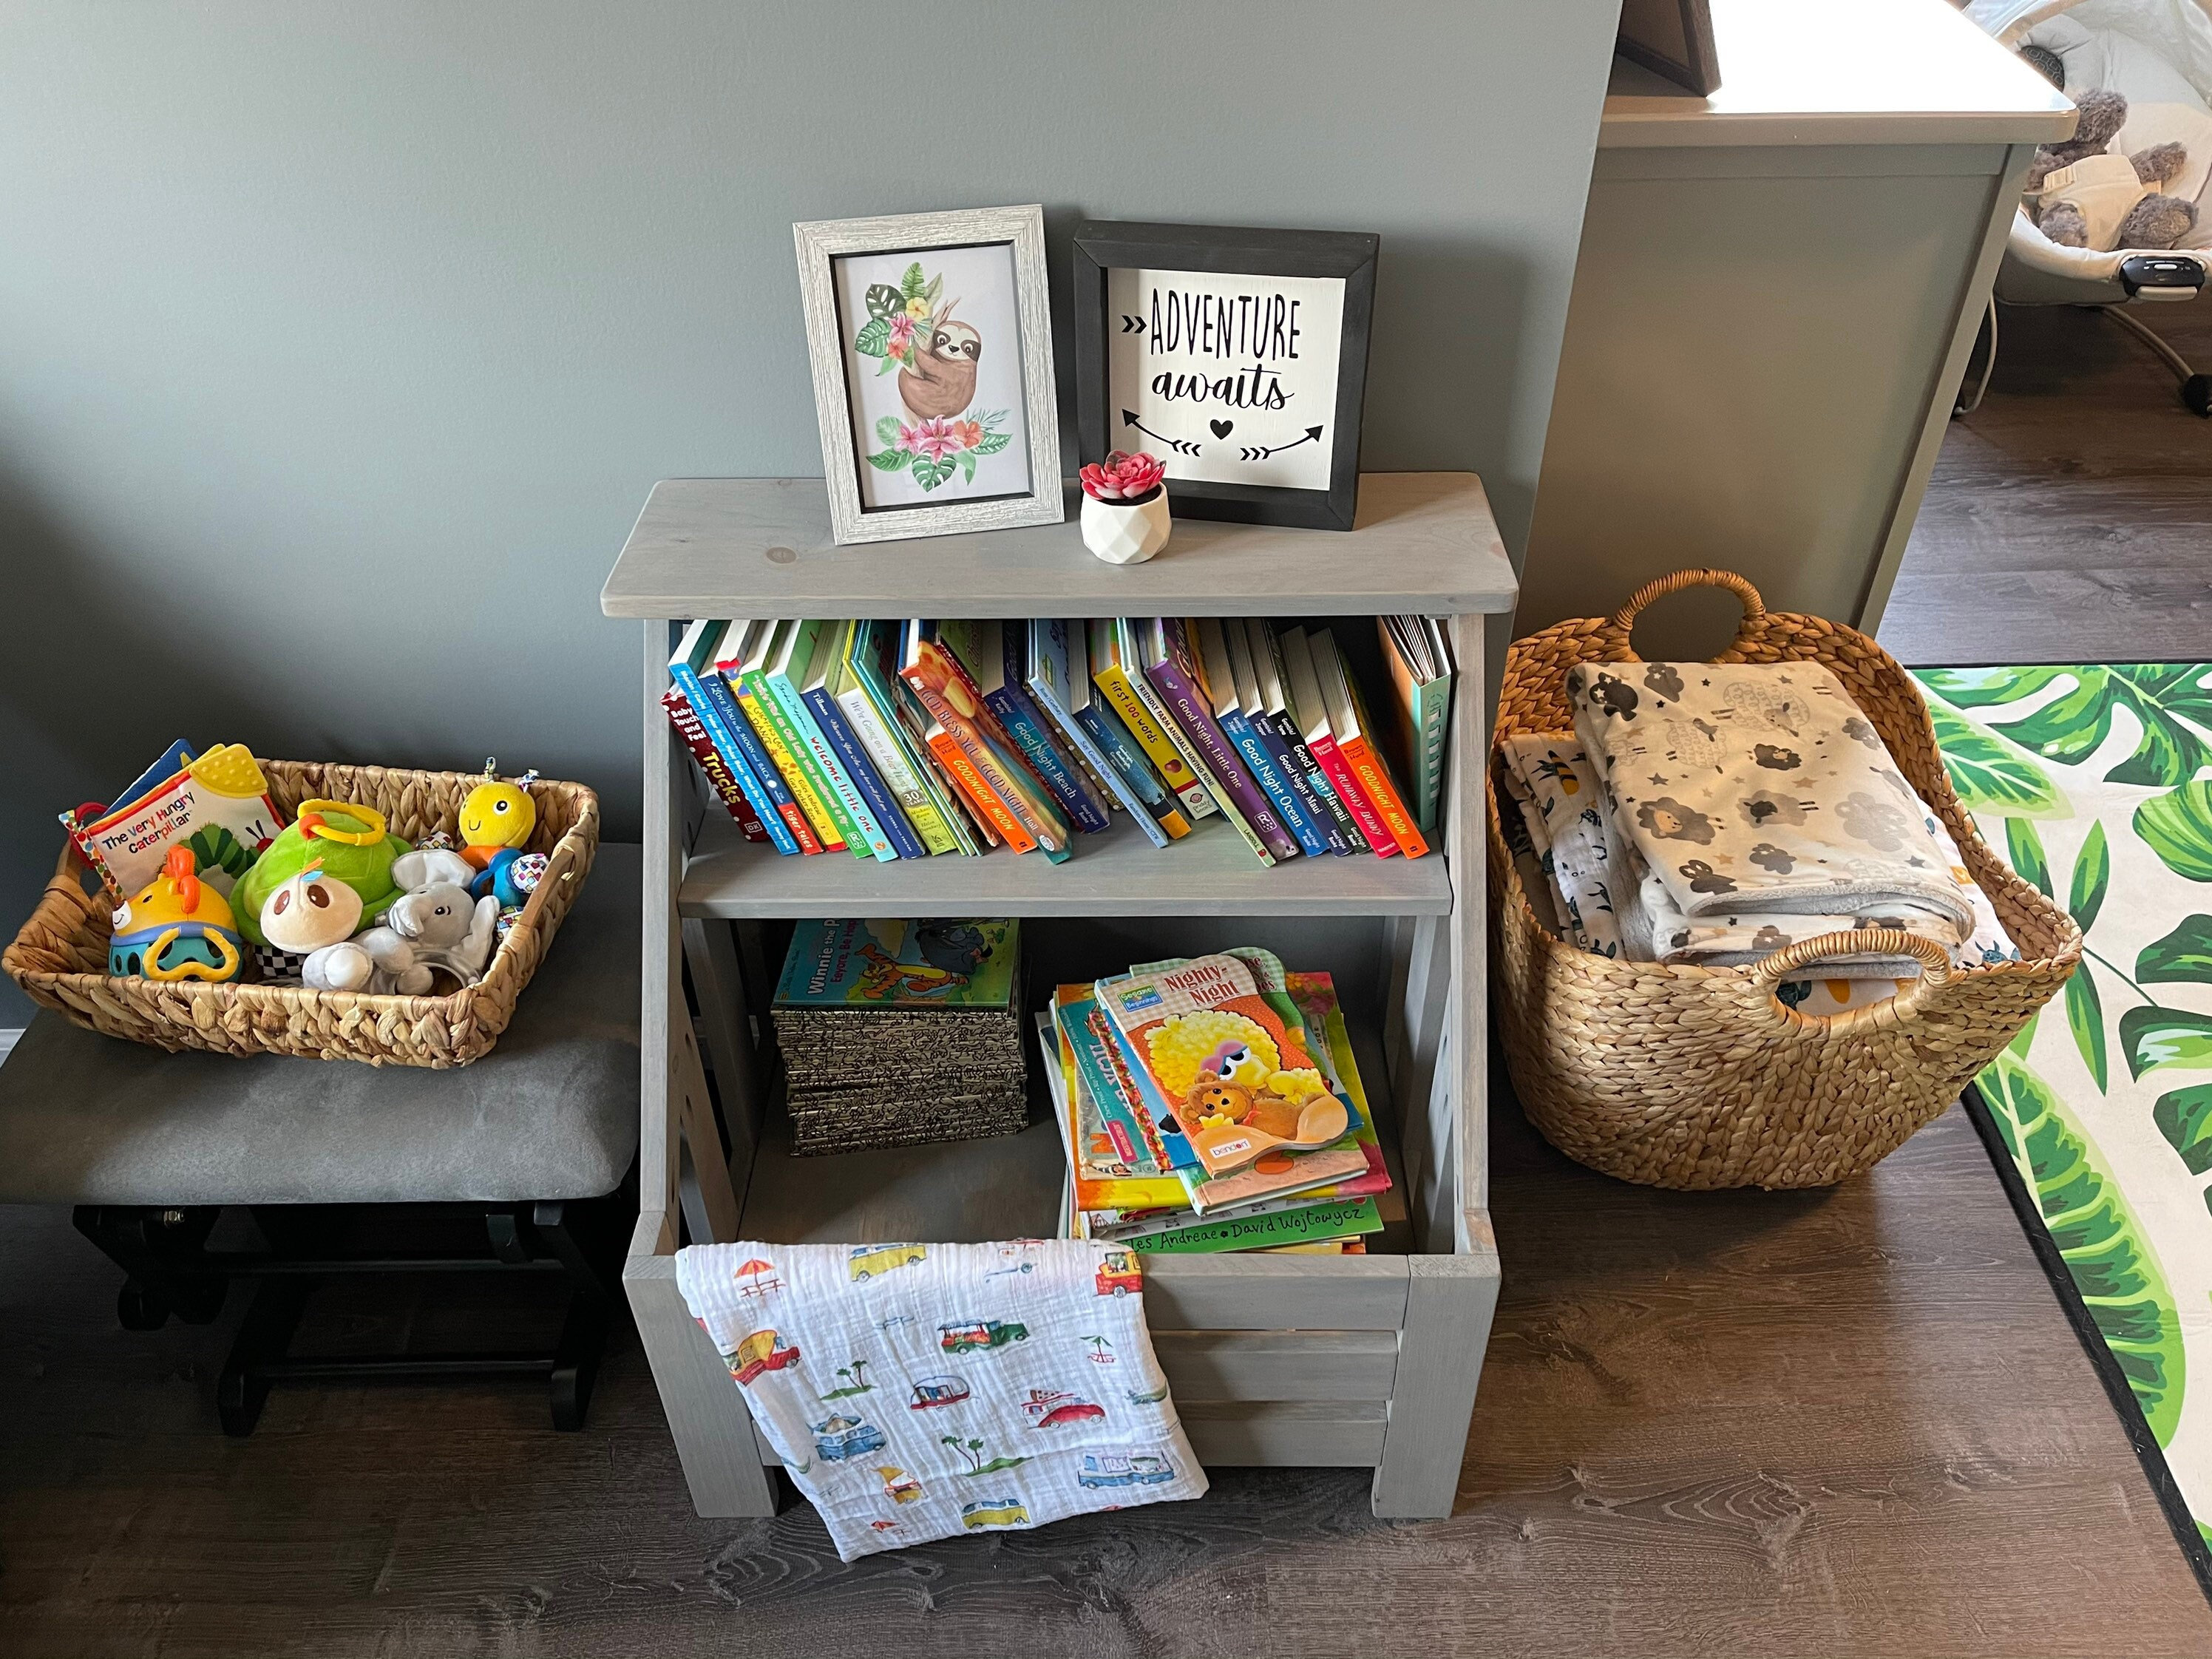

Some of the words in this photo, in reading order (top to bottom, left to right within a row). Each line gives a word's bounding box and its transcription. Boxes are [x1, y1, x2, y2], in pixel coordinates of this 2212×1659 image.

[1150, 288, 1300, 361] ADVENTURE
[1152, 363, 1295, 410] awaits
[671, 708, 693, 718] Baby
[674, 714, 699, 726] Touch
[684, 723, 701, 733] and
[813, 692, 828, 715] Tillman
[1110, 681, 1129, 701] first
[1124, 702, 1139, 718] 100
[1137, 719, 1158, 743] words
[688, 730, 707, 742] Feel
[706, 713, 718, 728] Polar
[744, 775, 755, 790] What
[752, 790, 759, 798] Do
[758, 798, 766, 809] You
[722, 705, 736, 720] YOU
[739, 733, 755, 753] MOON
[758, 763, 770, 778] BACK
[850, 701, 864, 719] We're
[862, 719, 877, 740] Going
[883, 755, 897, 770] Bear
[921, 688, 942, 710] GOD
[937, 710, 963, 737] BLESS
[961, 736, 980, 756] YOU
[980, 762, 1005, 790] GOOD
[1000, 787, 1026, 816] NIGHT
[1015, 722, 1038, 745] Good
[1031, 744, 1056, 770] Night
[1053, 771, 1076, 798] Beach
[1080, 740, 1089, 750] Say
[1088, 750, 1102, 764] Good
[1099, 764, 1111, 779] Night
[1137, 684, 1158, 710] FRIENDLY
[1156, 710, 1170, 727] FARM
[1168, 727, 1189, 752] ANIMALS
[1187, 751, 1204, 773] HAVING
[1201, 773, 1214, 786] FUN!
[1178, 699, 1198, 722] Good
[1193, 721, 1213, 748] Night,
[1211, 747, 1229, 770] Little
[1227, 770, 1241, 787] One
[703, 752, 741, 804] Trucks
[811, 737, 841, 781] welcome
[838, 784, 858, 811] little
[858, 815, 873, 832] one
[903, 791, 920, 802] 30
[907, 798, 924, 807] YEARS
[954, 760, 995, 803] GOODNIGHT
[991, 808, 1014, 830] MOON
[1242, 739, 1266, 765] Good
[1259, 765, 1283, 794] Night
[1280, 795, 1303, 827] Ocean
[1279, 754, 1297, 773] Good
[1291, 773, 1309, 794] Night
[1306, 795, 1323, 814] Maui
[1293, 744, 1314, 767] Good
[1306, 765, 1329, 791] Night
[1323, 791, 1348, 821] Hawaii
[1359, 764, 1395, 810] GOODNIGHT
[1388, 812, 1410, 835] MOON
[102, 832, 129, 849] The
[155, 791, 195, 821] Hungry
[786, 810, 801, 828] tiger
[798, 830, 812, 847] tales
[1024, 816, 1038, 830] Hall
[1336, 773, 1366, 808] RUNAWAY
[1359, 810, 1384, 836] BUNNY
[807, 947, 834, 994] Winnie
[824, 929, 836, 946] the
[839, 939, 852, 950] Be
[1119, 985, 1153, 1001] Sesame
[1125, 996, 1160, 1008] Beginnings
[1164, 965, 1228, 991] Nighty-
[1189, 979, 1241, 1007] Night
[1212, 1140, 1249, 1156] bendon
[1160, 1228, 1218, 1249] Andreae
[1230, 1216, 1276, 1238] David
[1278, 1209, 1365, 1233] Wojtowycz
